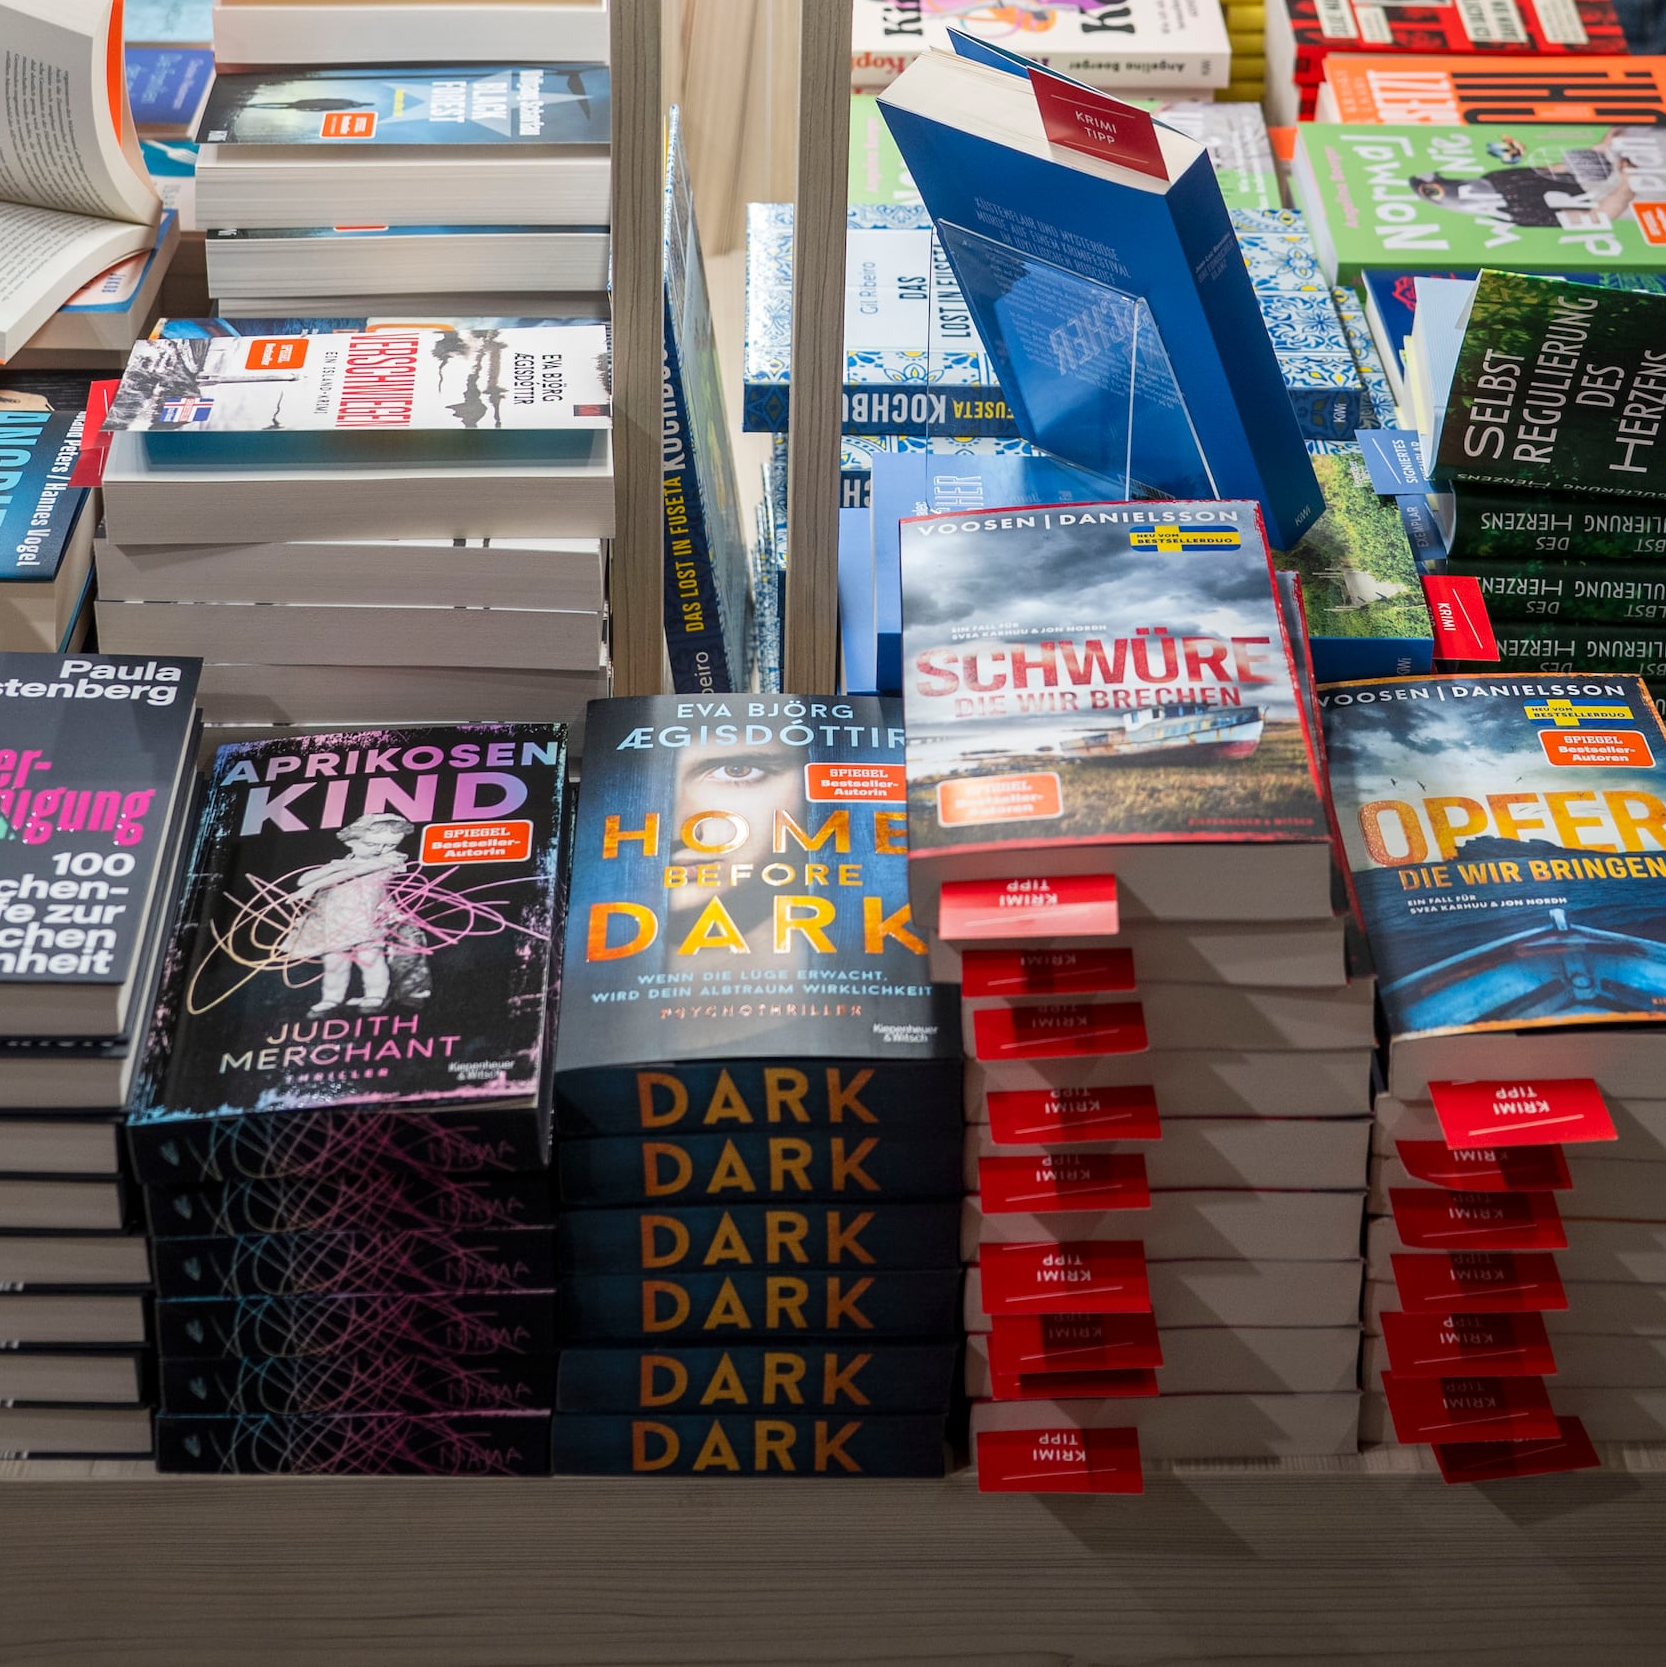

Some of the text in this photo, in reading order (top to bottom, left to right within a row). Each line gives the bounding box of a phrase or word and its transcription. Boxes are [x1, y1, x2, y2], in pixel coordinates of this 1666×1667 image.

[1074, 110, 1118, 134] KRIMI
[1083, 127, 1117, 146] TIPP
[859, 260, 880, 316] Gil Ribeiro
[898, 275, 928, 301] DAS
[940, 305, 972, 339] LOST
[324, 350, 339, 365] EIN
[335, 332, 419, 428] VERSCHWIEGEN
[541, 353, 564, 403] EVA BJÖRG
[1512, 295, 1600, 464] REGULIERUNG
[1575, 362, 1626, 408] DES
[1463, 348, 1526, 461] SELBST
[1391, 438, 1419, 485] SIGNIERTES
[15, 439, 84, 568] Peters Hannes Vogel
[918, 509, 1240, 538] VOOSEN DANIELSSON
[1480, 512, 1573, 531] HERZENS
[664, 476, 705, 633] DAS LOST IN FUSETA
[1534, 536, 1570, 552] DES
[1436, 601, 1457, 632] KRIMI
[59, 658, 183, 683] Paula
[915, 626, 1278, 698] SCHWÜRE
[953, 686, 1243, 719] DIE WIR BRECHEN
[1451, 683, 1626, 699] DANIELSSON
[676, 699, 855, 720] EVA BJÖRG
[1531, 705, 1575, 714] NEU VOM
[1533, 710, 1626, 720] BESTSELLERDUO
[615, 720, 906, 751] ÆGISDÓTTIR
[1562, 734, 1624, 747] SPIEGEL
[1557, 744, 1637, 756] Bestseller-
[1570, 752, 1630, 764] Autoren
[219, 740, 559, 787] APRIKOSEN
[828, 767, 889, 780] SPIEGEL
[819, 778, 900, 790] Bestseller-
[833, 787, 888, 798] Autorin
[239, 771, 529, 837] KIND
[430, 837, 521, 850] Bestseller-
[443, 826, 511, 839] SPIEGEL
[600, 809, 908, 860] HOME
[51, 851, 137, 878] 100
[443, 847, 507, 858] Autorin
[662, 863, 864, 889] BEFORE
[1006, 879, 1050, 892] TIPP
[1398, 865, 1453, 891] DIE
[1456, 861, 1523, 886] WIR
[998, 892, 1058, 907] KRIMI
[1406, 893, 1477, 907] EIN FALL FÜR
[1409, 904, 1438, 914] SVEA
[1438, 901, 1489, 912] KARHUU
[1500, 899, 1523, 908] JON
[1525, 896, 1569, 906] NORDH
[42, 903, 127, 926] zur
[585, 894, 930, 963] DARK
[637, 970, 695, 985] WENN
[702, 969, 732, 983] DIE
[739, 967, 789, 983] LÜGE
[591, 982, 933, 1004] WIRD DEIN ALBTRAUM WIRKLICHKEIT
[265, 1013, 419, 1045] JUDITH
[218, 1035, 462, 1075] MERCHANT
[635, 1066, 881, 1129] DARK
[1495, 1086, 1537, 1099] TIPP
[1043, 1099, 1101, 1114] KRIMI
[1492, 1100, 1551, 1115] KRIMI
[1042, 1254, 1083, 1268] TIPP
[1035, 1269, 1093, 1284] KRIMI
[640, 1275, 876, 1334] DARK
[630, 1419, 864, 1473] DARK
